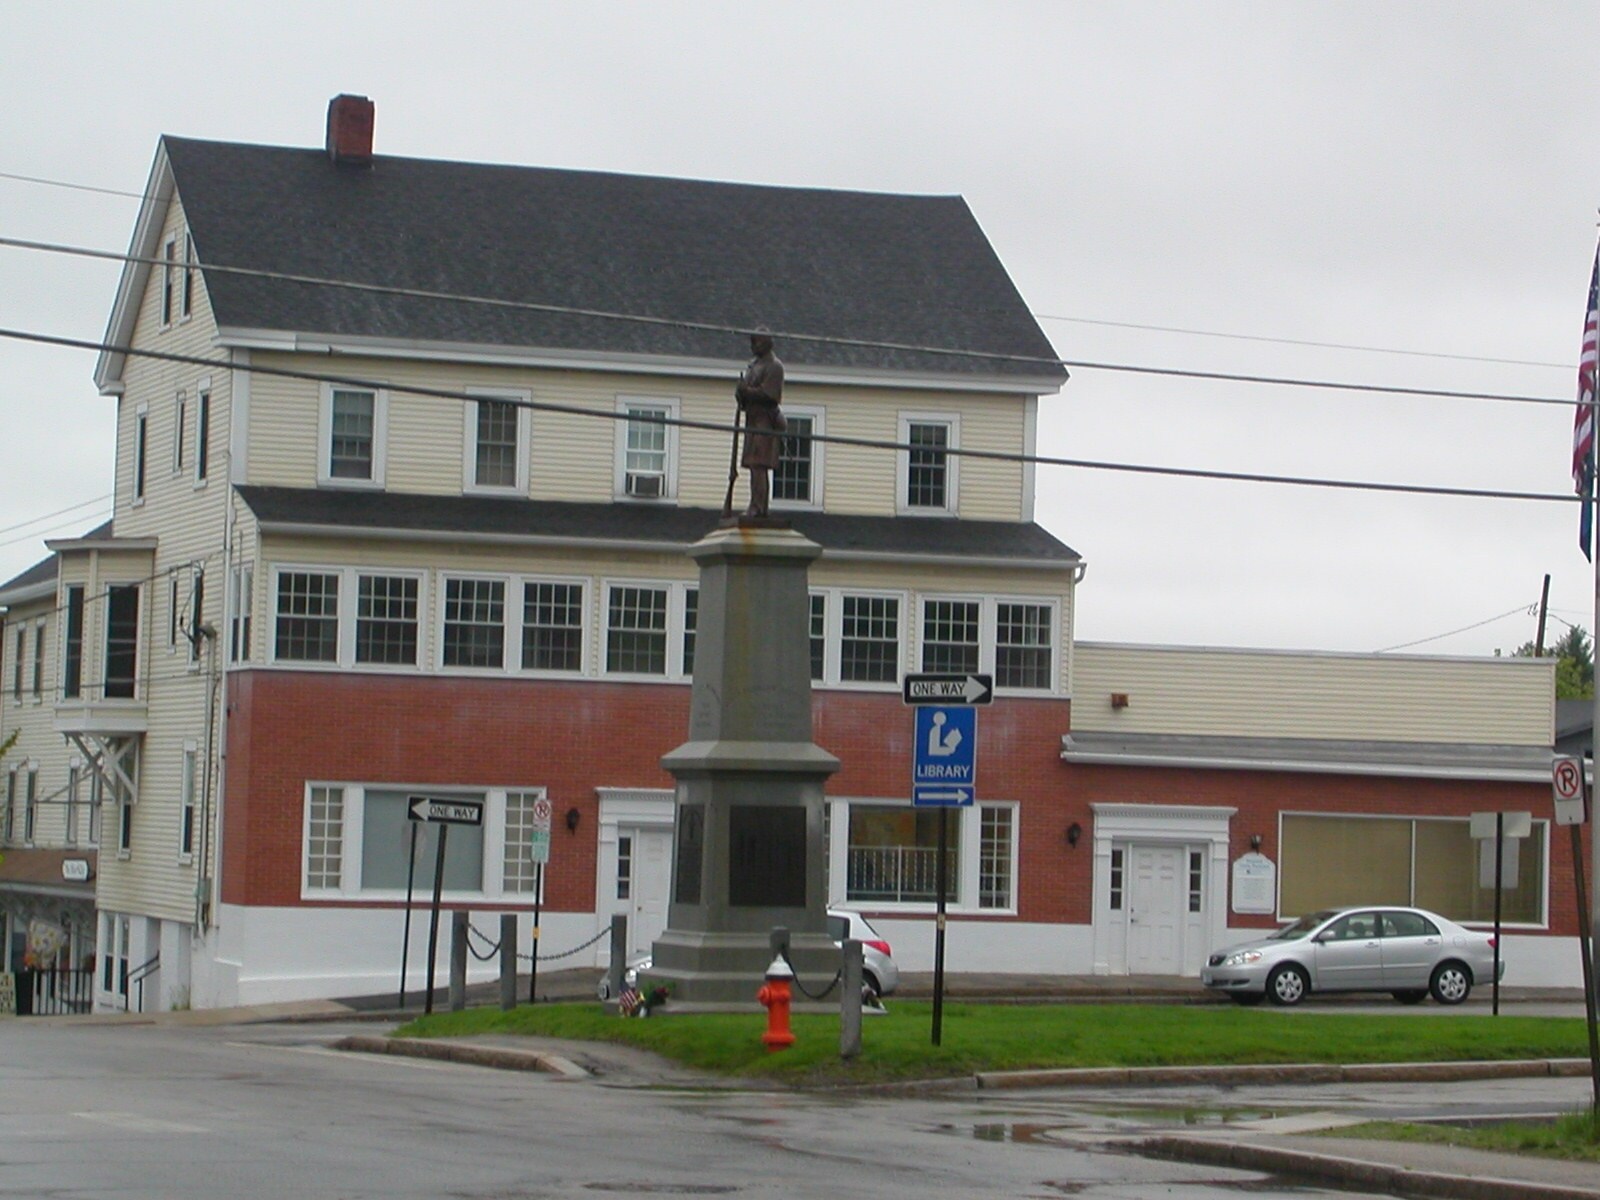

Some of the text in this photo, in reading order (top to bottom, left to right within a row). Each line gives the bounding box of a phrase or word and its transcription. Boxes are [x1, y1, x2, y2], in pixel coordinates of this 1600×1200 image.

[913, 683, 965, 695] ONE WAY
[917, 764, 970, 778] LIBRARY
[429, 806, 475, 819] ONE WAY
